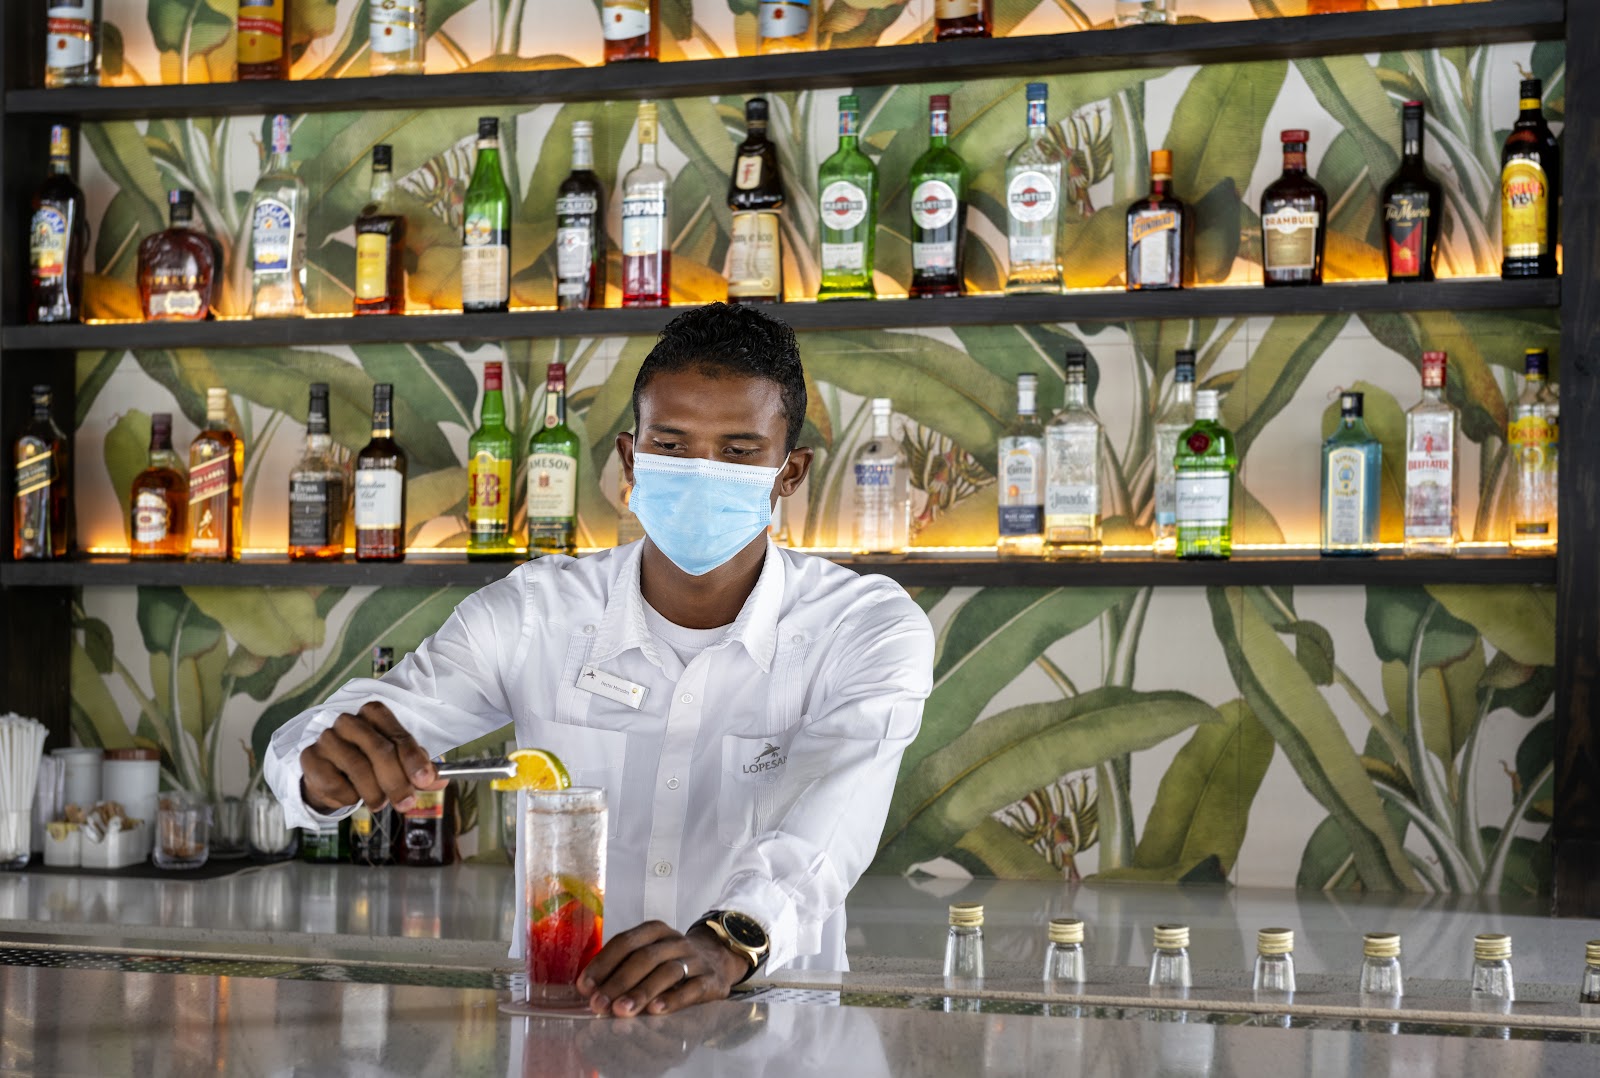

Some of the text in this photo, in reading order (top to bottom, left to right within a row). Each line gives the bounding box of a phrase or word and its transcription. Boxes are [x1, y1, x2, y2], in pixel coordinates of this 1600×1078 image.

[1011, 191, 1051, 203] MARTINI
[622, 201, 664, 215] AMPARI
[823, 202, 863, 211] MARTINI
[914, 199, 952, 211] MARTINI
[529, 458, 571, 471] AMESON
